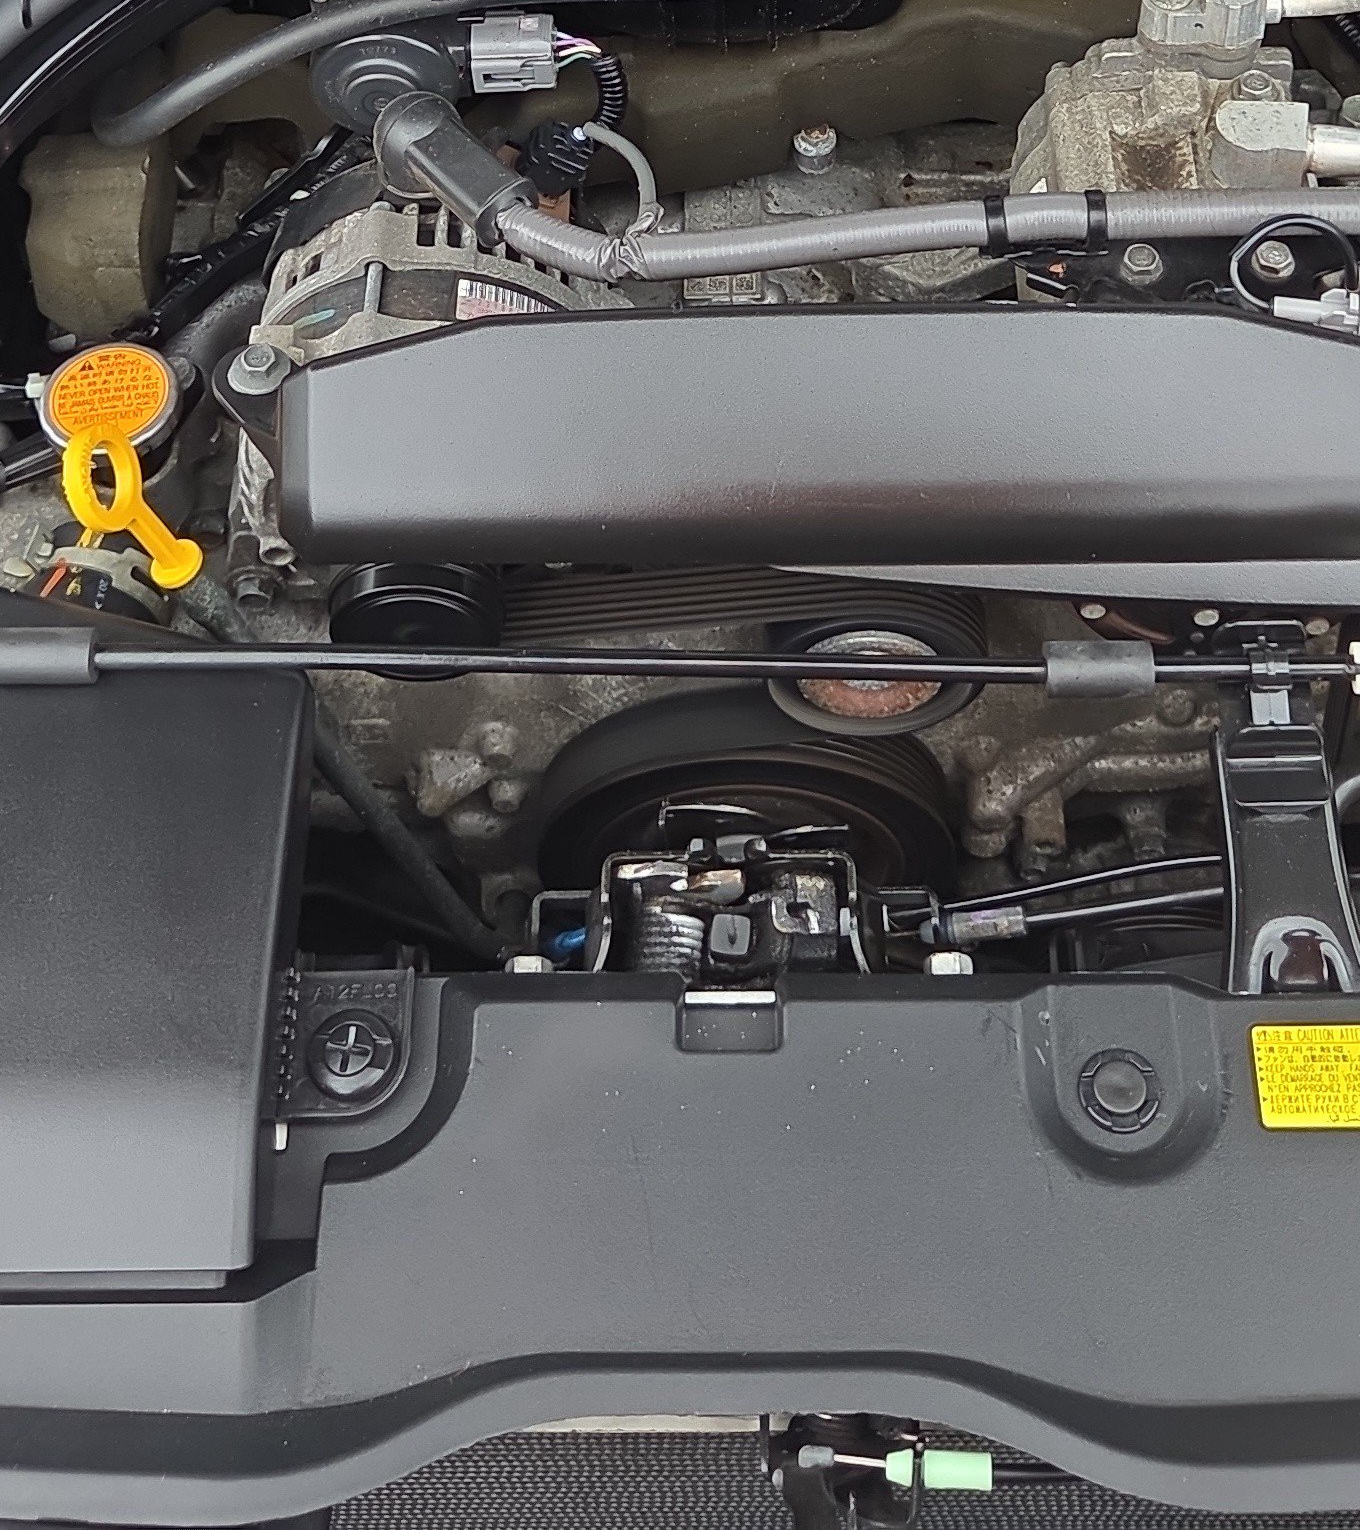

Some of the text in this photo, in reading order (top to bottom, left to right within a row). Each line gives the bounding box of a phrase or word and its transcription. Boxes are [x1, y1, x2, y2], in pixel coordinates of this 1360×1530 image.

[58, 390, 86, 400] NEVER
[88, 387, 110, 397] OPEN
[114, 383, 139, 393] WHEN
[73, 409, 144, 425] AVERTISSEMENT
[1297, 1028, 1334, 1041] CAUTION
[1265, 1064, 1285, 1072] KEEP
[1290, 1064, 1315, 1072] HANDS
[1266, 1073, 1275, 1083] LE
[1329, 1073, 1339, 1082] DU
[1267, 1084, 1289, 1093] N'EN
[1294, 1084, 1341, 1093] APPROCHEZ
